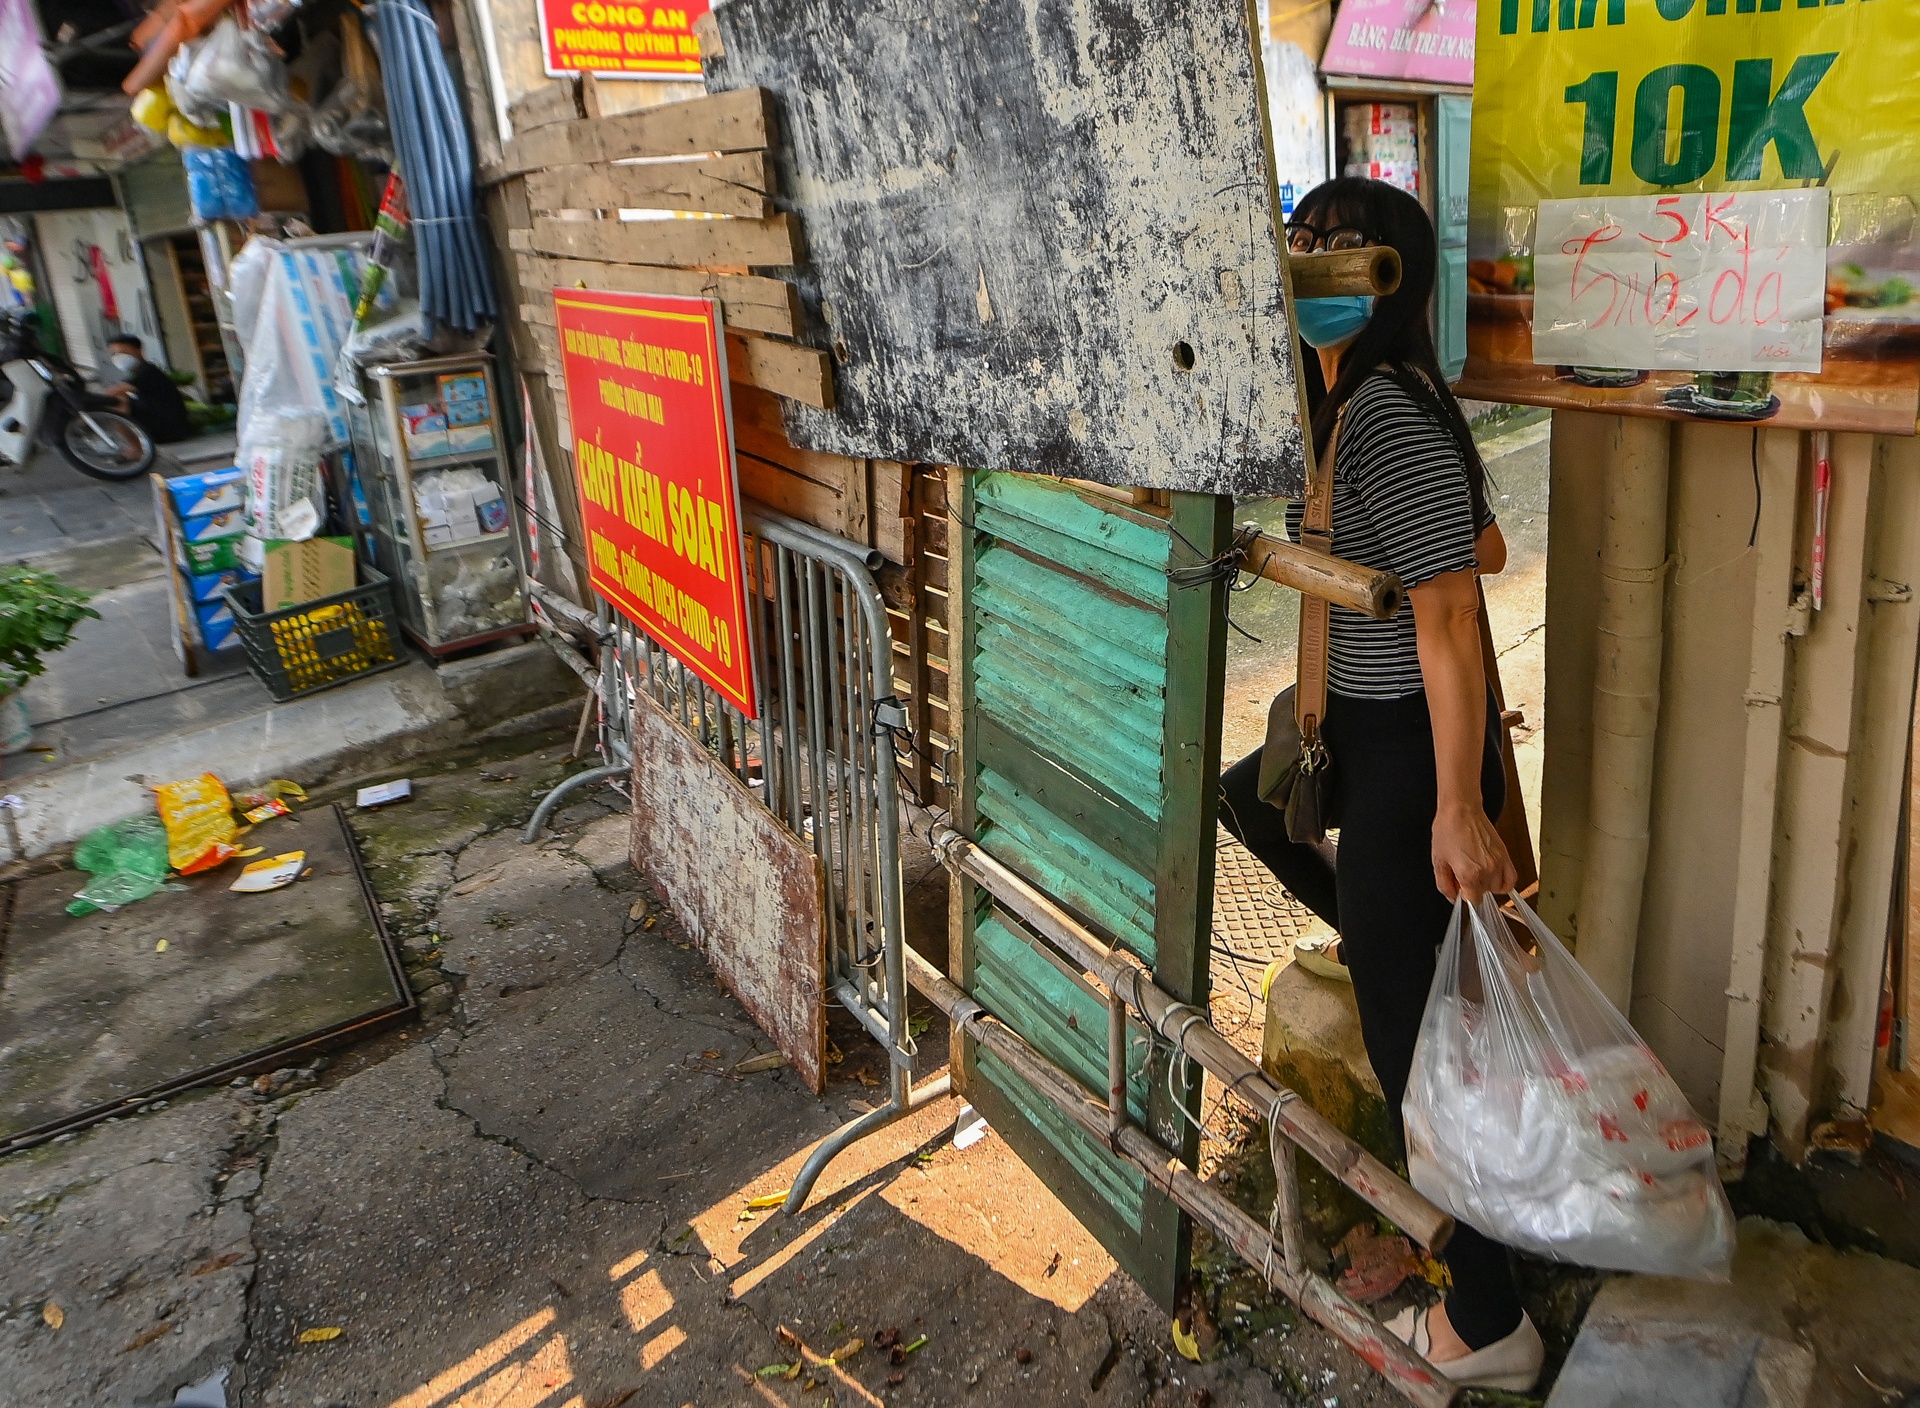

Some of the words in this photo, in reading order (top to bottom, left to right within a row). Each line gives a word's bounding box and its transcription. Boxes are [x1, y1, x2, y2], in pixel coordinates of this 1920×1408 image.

[571, 1, 646, 26] CÔNG
[652, 8, 687, 29] AN
[553, 26, 621, 51] PHƯỜNG
[624, 30, 676, 55] QUỲNH
[678, 35, 700, 55] MA
[560, 54, 621, 69] 100m
[1564, 52, 1840, 186] 10K
[645, 344, 666, 381] DỊCH
[665, 347, 704, 387] COVID-19
[578, 425, 619, 517] CHỐT
[617, 440, 669, 548] KIỂM
[667, 477, 726, 583] SOÁT
[620, 544, 654, 610] CHỐNG
[650, 571, 680, 629] DỊCH
[677, 589, 733, 669] COVID-19
